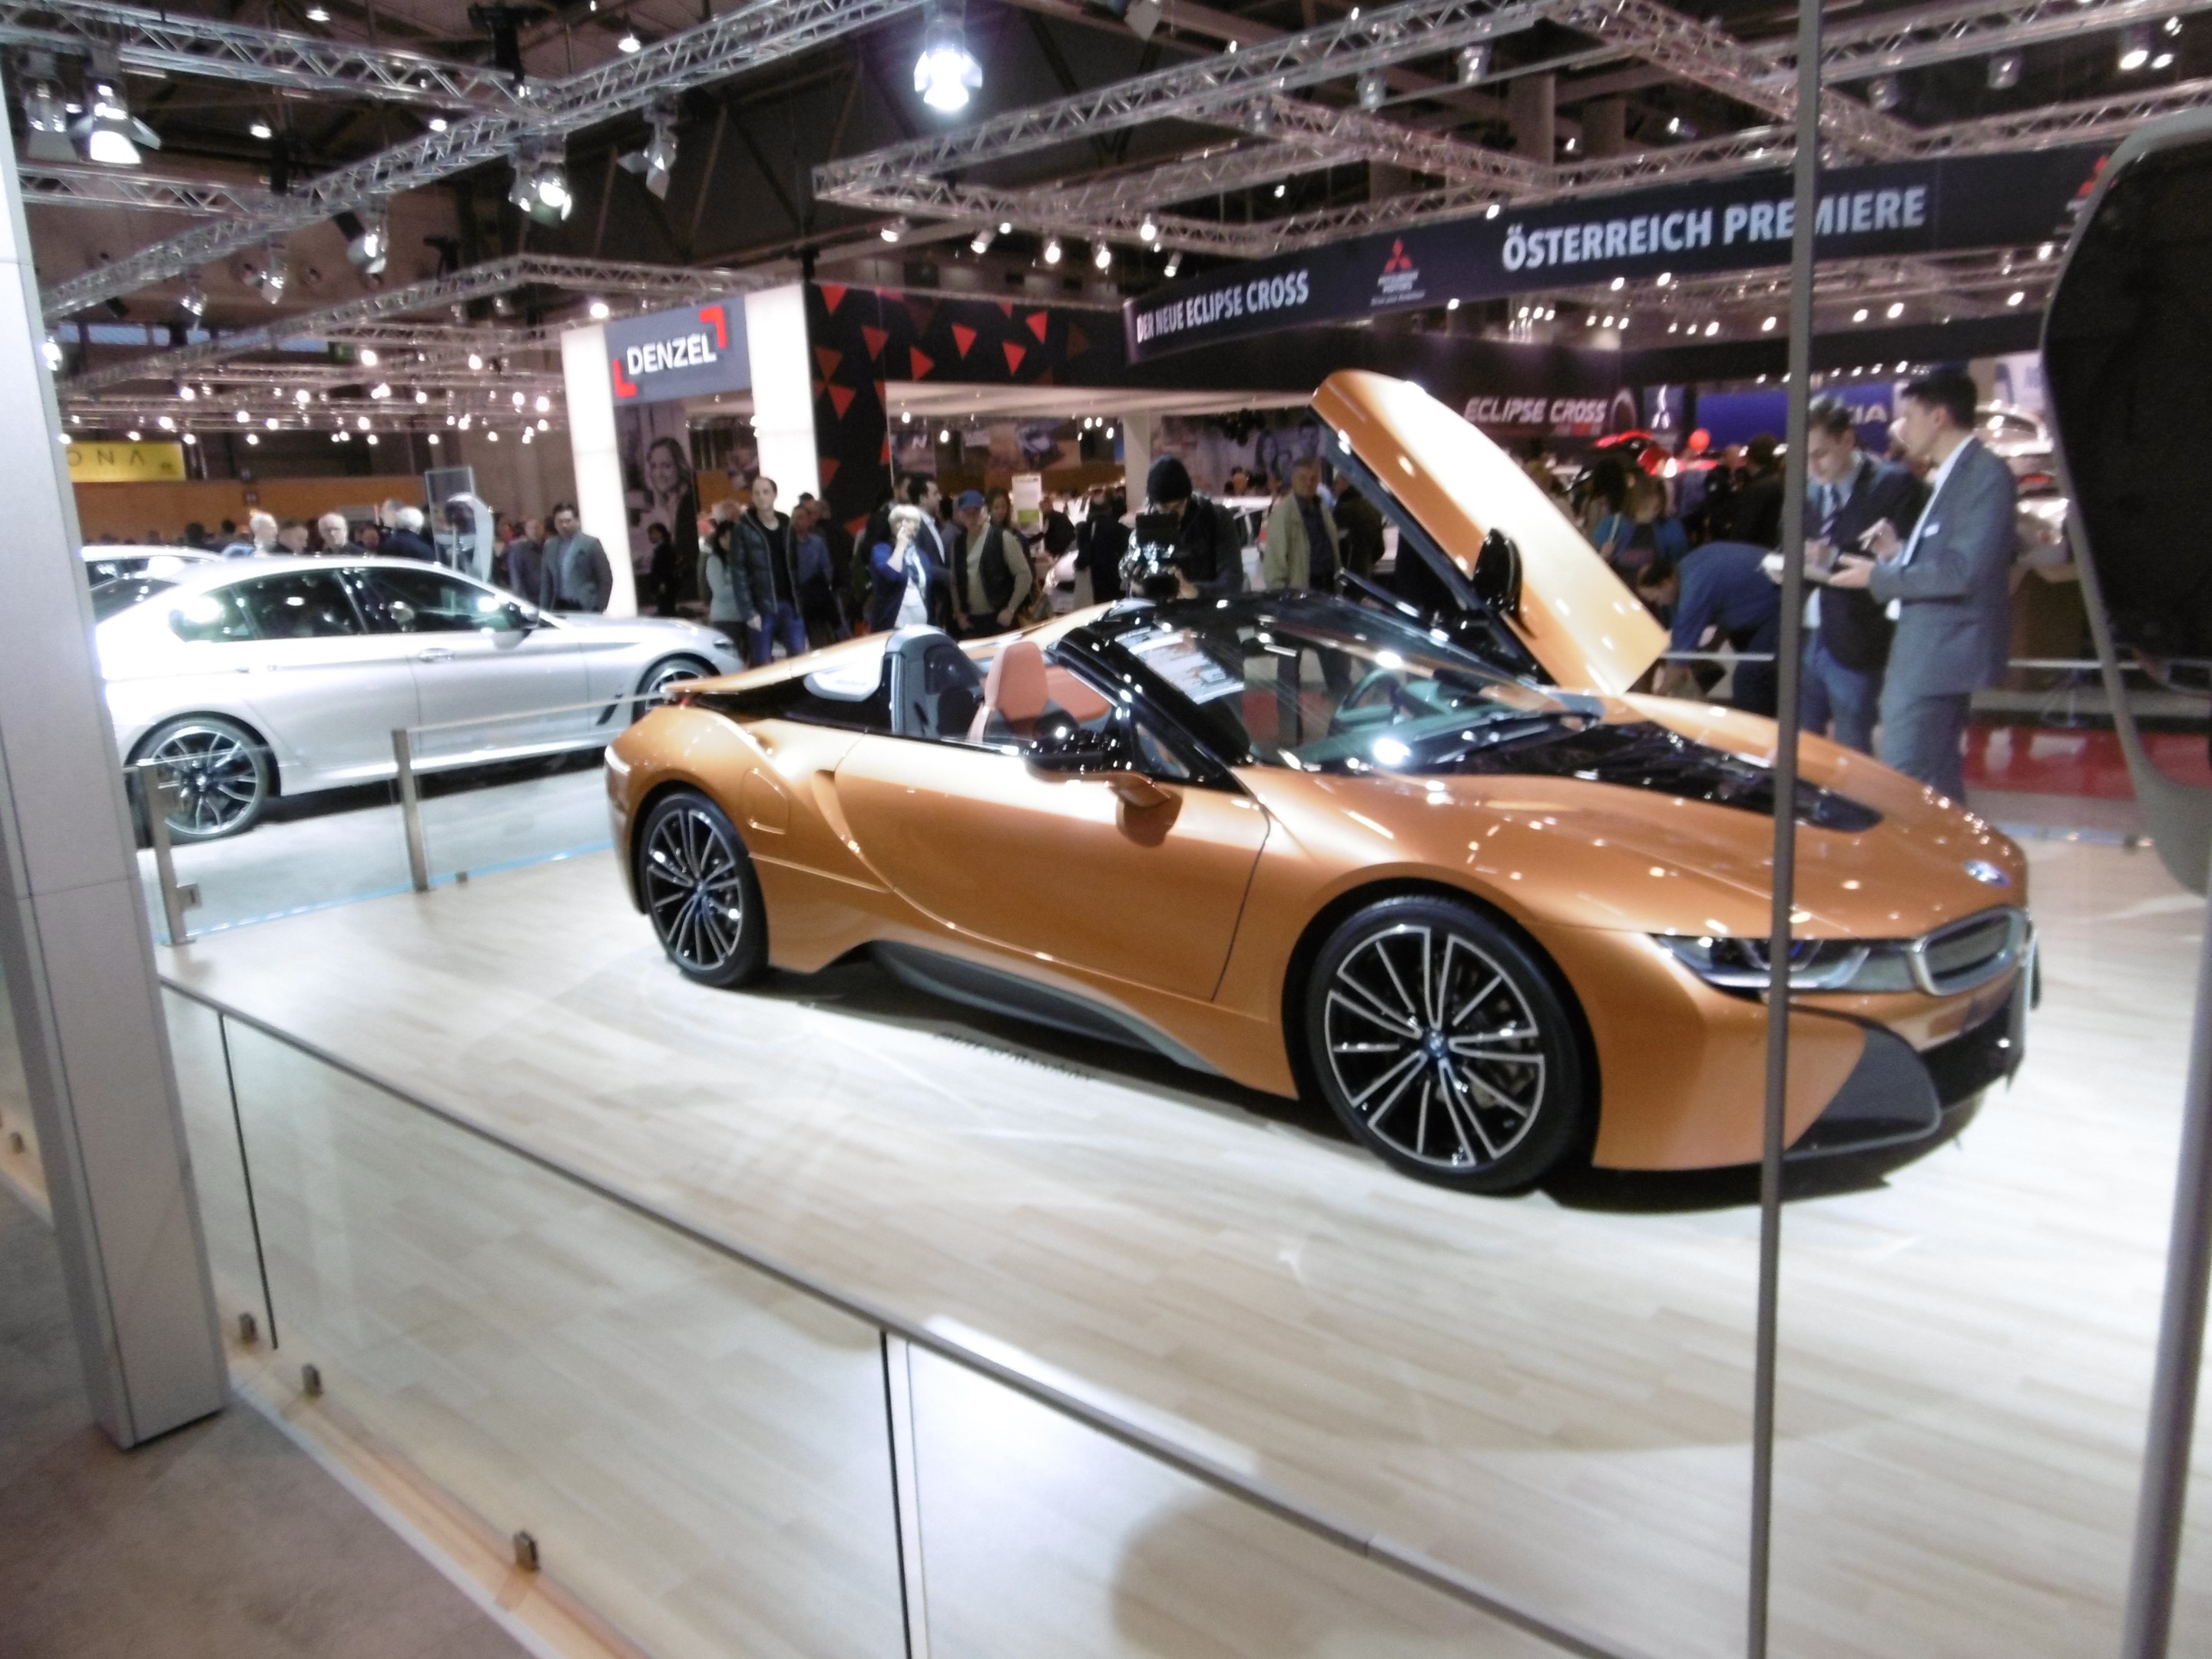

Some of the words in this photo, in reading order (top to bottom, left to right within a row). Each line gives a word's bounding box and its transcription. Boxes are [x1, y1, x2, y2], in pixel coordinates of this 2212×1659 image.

[1502, 207, 1713, 272] ÖSTERREICH
[1723, 187, 1926, 245] PREMIERE
[1155, 301, 1184, 336] NEUE
[1186, 286, 1243, 327] ECLIPSE
[1246, 270, 1309, 313] CROSS
[627, 333, 717, 375] DENZEL
[1464, 397, 1547, 423] ECLIPSE
[1549, 399, 1608, 423] CROSS
